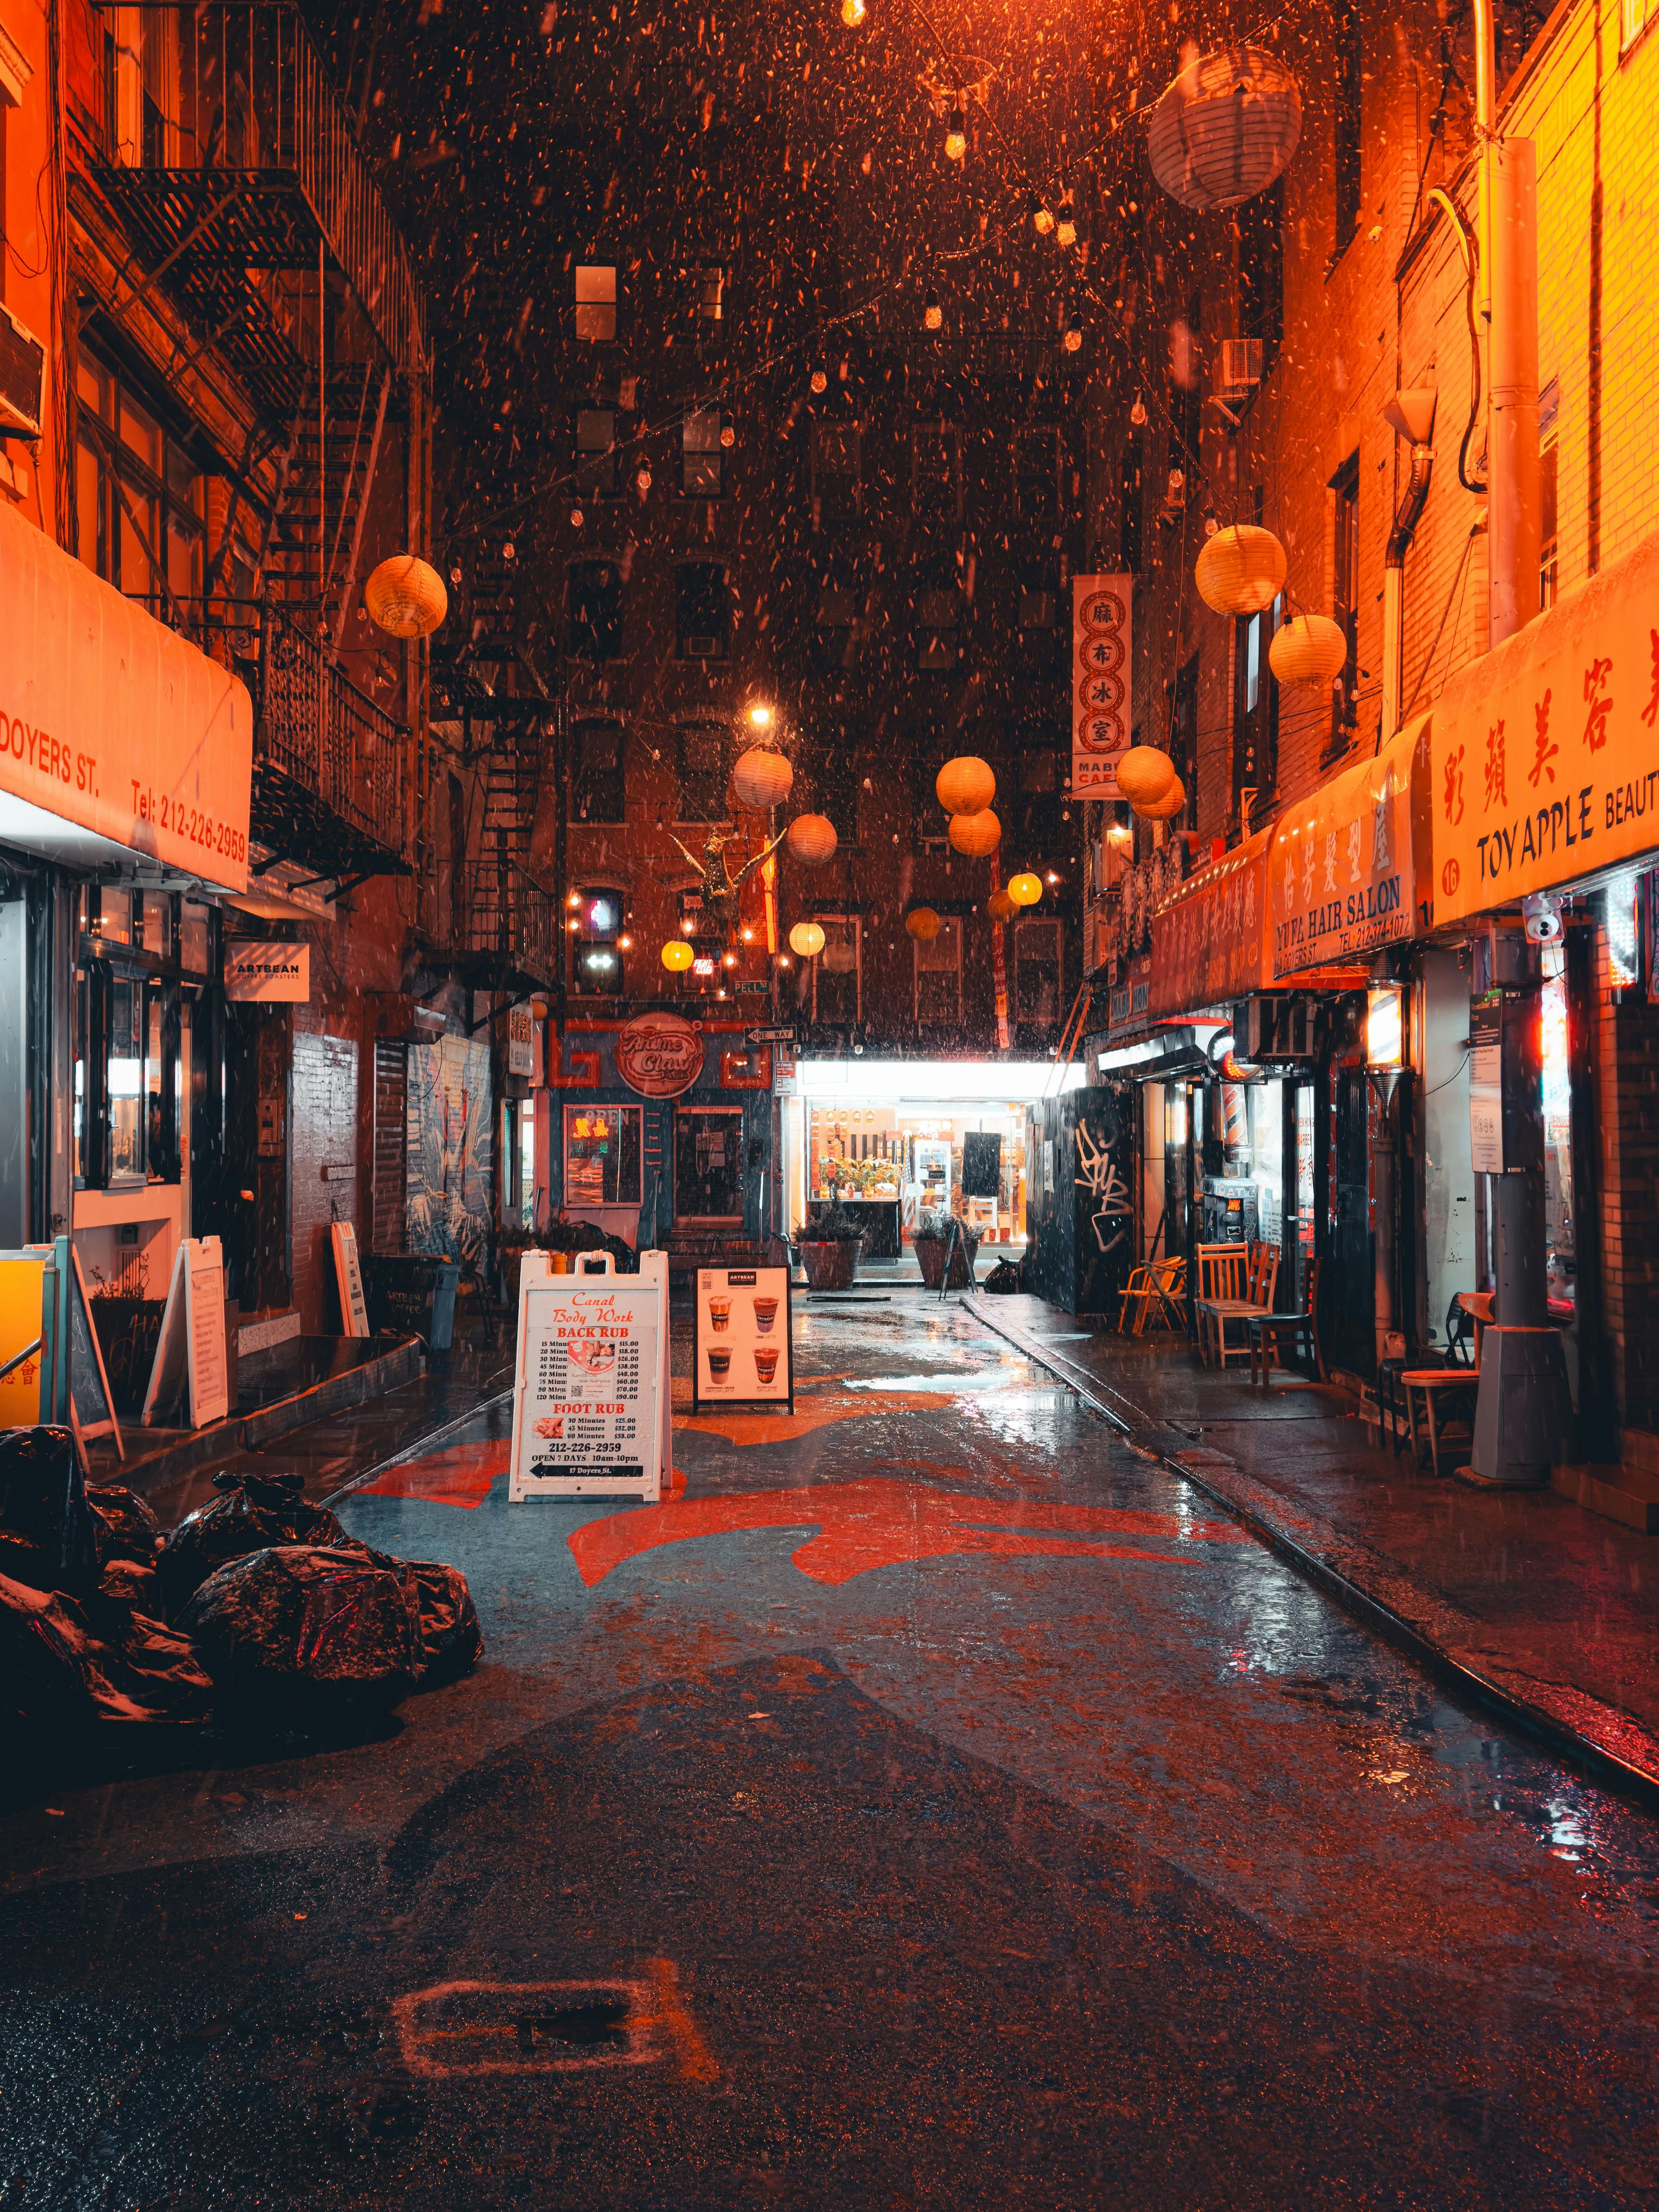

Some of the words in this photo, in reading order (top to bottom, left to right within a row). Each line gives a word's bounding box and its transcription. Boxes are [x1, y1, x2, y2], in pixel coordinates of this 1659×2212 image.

[1091, 602, 1113, 741] 麻布冰室
[0, 710, 71, 783] DOYERS
[77, 752, 99, 797] ST.
[1079, 774, 1116, 783] CAF
[132, 779, 155, 823] Tel:
[161, 795, 245, 863] 212-226-2959
[1308, 900, 1342, 939] HAIR
[1347, 875, 1400, 926] SALON
[237, 964, 299, 973] ARTBEAN
[735, 983, 760, 993] PELL
[623, 1030, 684, 1052] Anime
[641, 1053, 691, 1072] Claw
[585, 1110, 629, 1126] OPEN
[572, 1292, 614, 1306] Canal
[553, 1309, 586, 1325] Body
[595, 1309, 633, 1322] Work
[557, 1328, 596, 1337] BACK
[599, 1328, 628, 1338] RUB
[553, 1404, 591, 1414] FOOT
[595, 1404, 625, 1414] RUB
[549, 1443, 621, 1452] 212-226-2959
